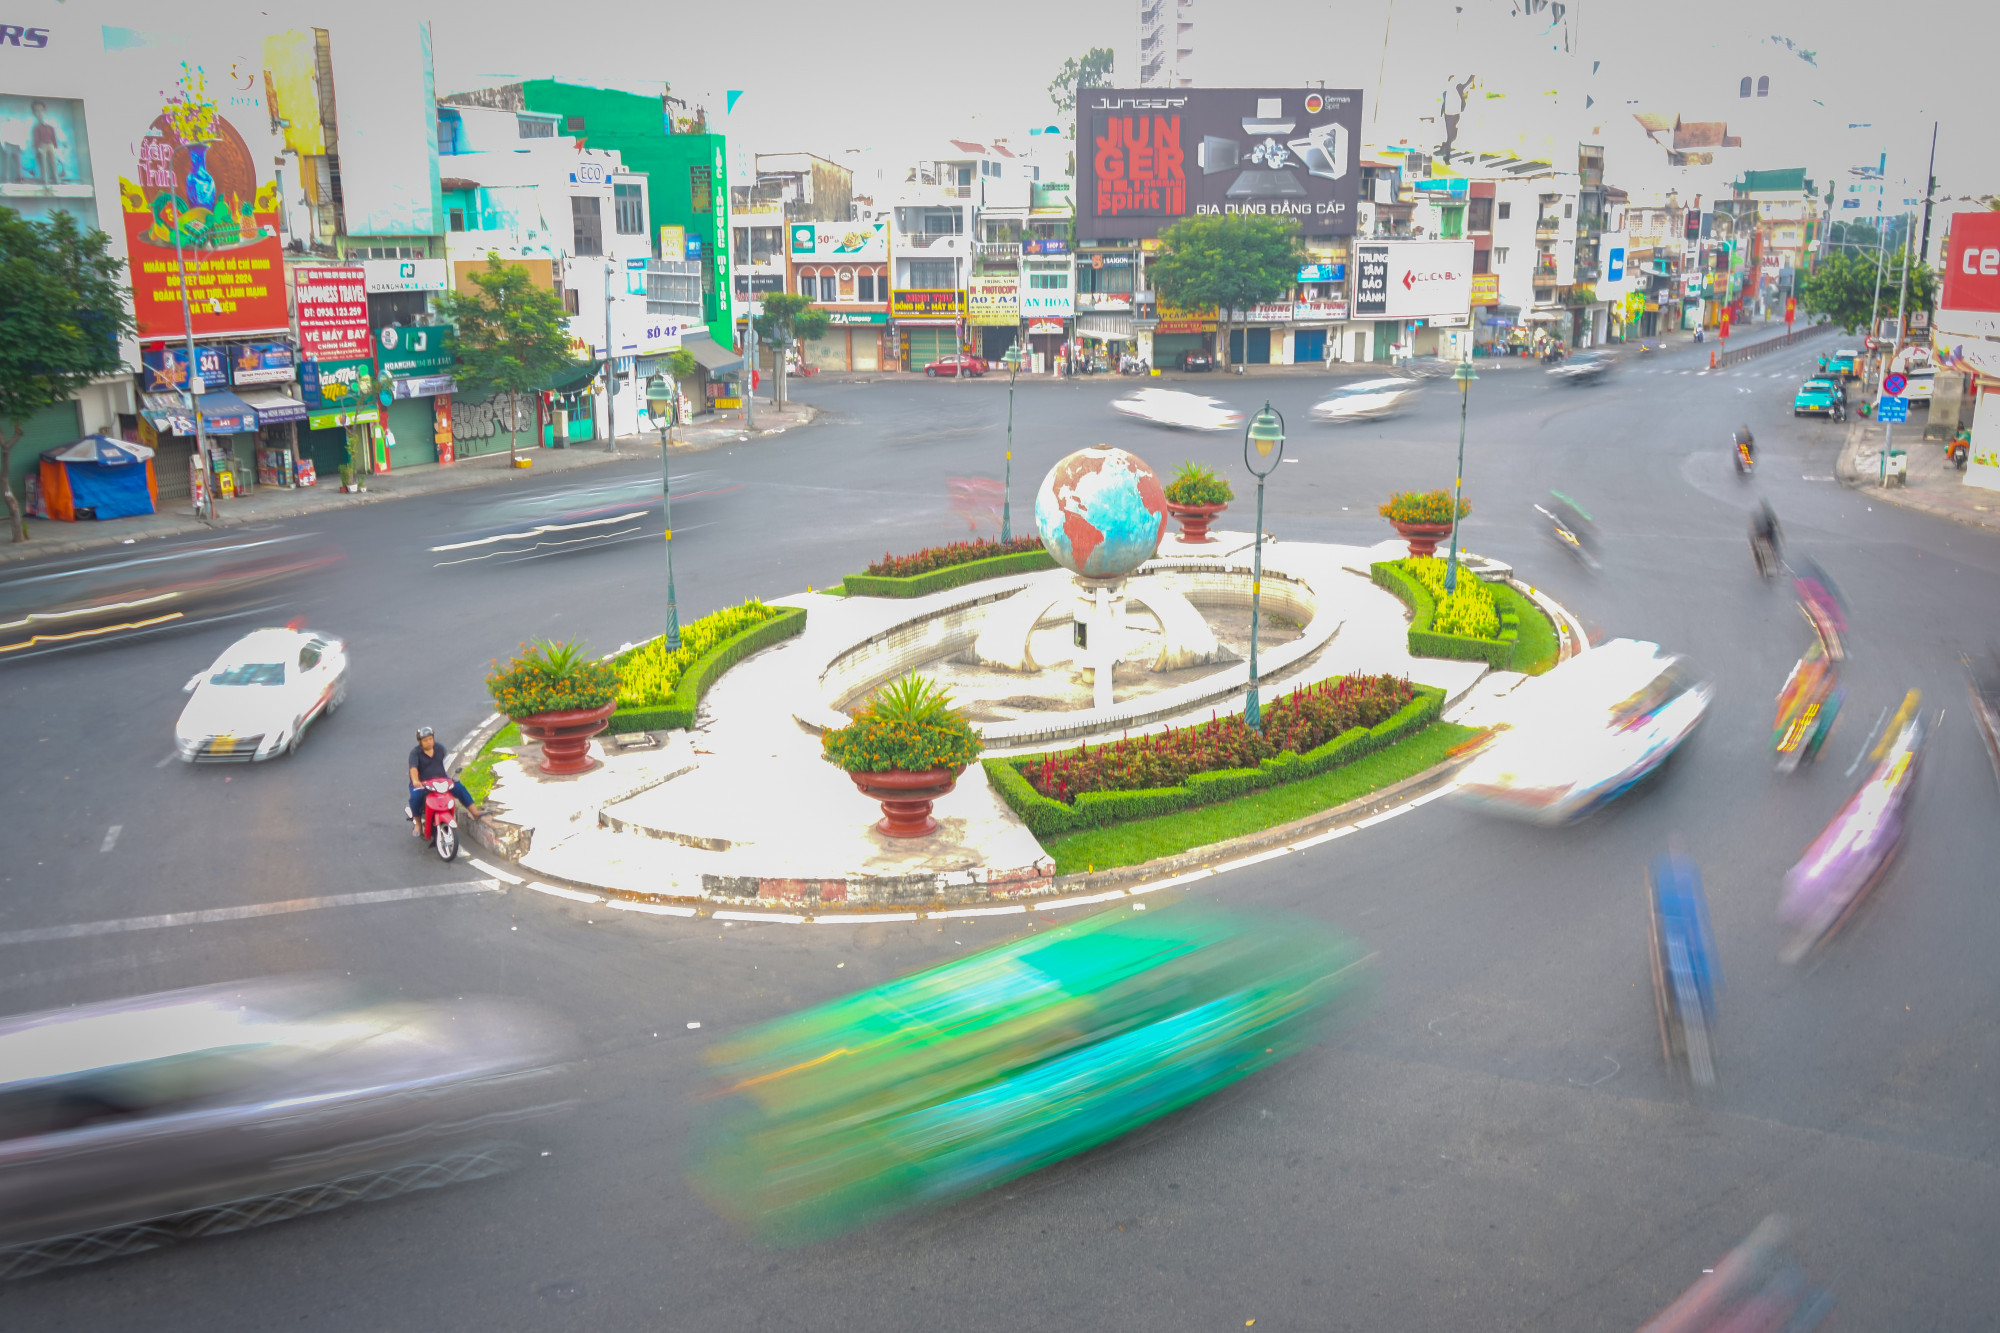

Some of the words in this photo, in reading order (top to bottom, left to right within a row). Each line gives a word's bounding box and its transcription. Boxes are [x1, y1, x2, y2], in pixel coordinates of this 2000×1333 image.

[1092, 98, 1184, 109] JUNGER
[1096, 114, 1180, 149] JUN
[1095, 148, 1185, 180] GER
[581, 166, 600, 180] ECO
[1196, 204, 1220, 215] GIA
[1359, 253, 1388, 263] TRUNG
[1363, 264, 1384, 275] TÂM
[297, 285, 339, 303] HAPPINESS
[338, 284, 366, 303] TRAVEL
[982, 286, 1018, 294] PHOTOCOPY
[905, 294, 930, 303] MINH
[1358, 290, 1385, 302] HÀNH
[1024, 298, 1040, 307] AN
[848, 315, 872, 323] Company
[347, 329, 366, 340] BAY
[664, 326, 677, 337] 42
[200, 355, 220, 371] 341
